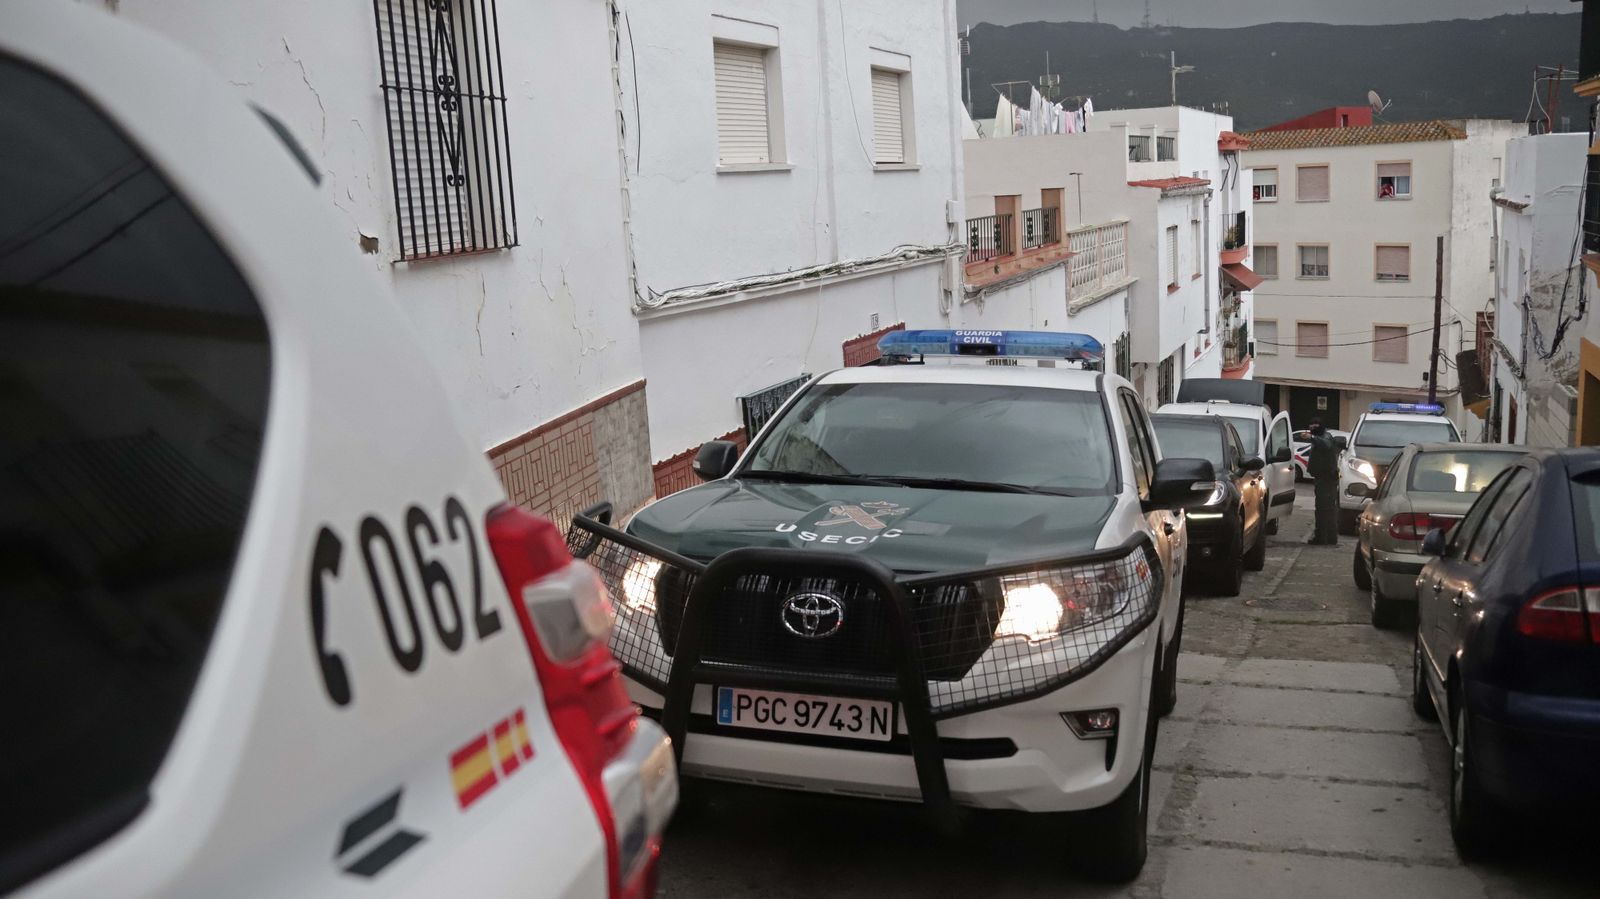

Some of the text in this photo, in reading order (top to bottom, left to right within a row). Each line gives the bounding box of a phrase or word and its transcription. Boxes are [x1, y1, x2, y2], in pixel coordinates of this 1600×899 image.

[963, 336, 992, 344] CIVIL
[775, 523, 903, 545] USECIC
[360, 496, 502, 672] 062
[722, 709, 728, 718] E
[736, 694, 888, 735] PGC 9743 N
